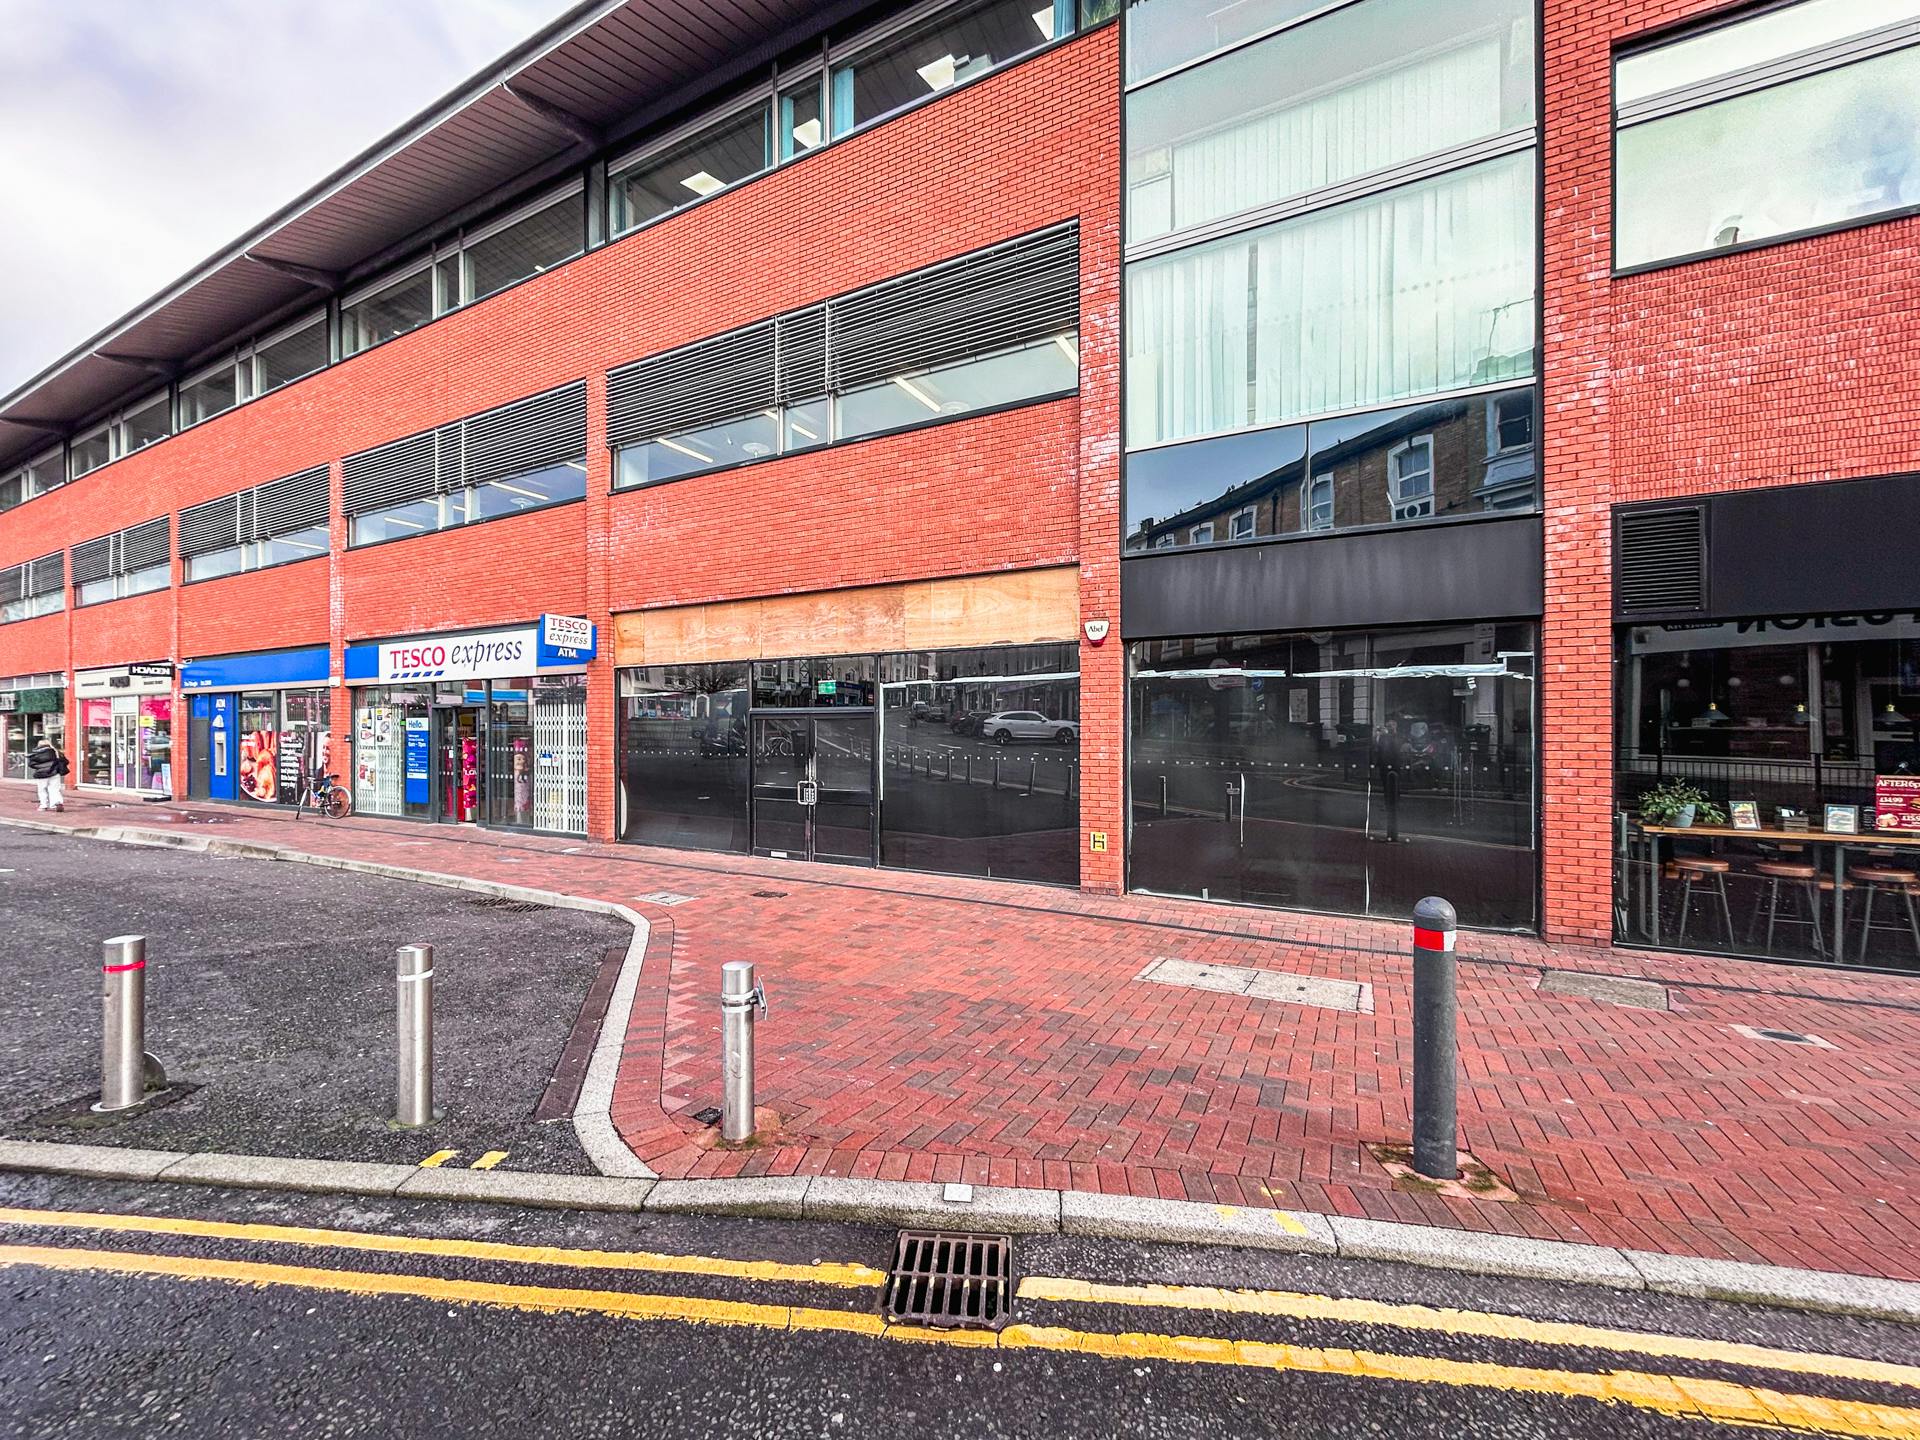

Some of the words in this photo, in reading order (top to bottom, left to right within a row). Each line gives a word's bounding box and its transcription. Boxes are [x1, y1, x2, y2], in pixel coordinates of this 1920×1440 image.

[549, 618, 588, 631] TESCO
[550, 633, 588, 645] express
[390, 646, 446, 669] TESCO
[451, 640, 522, 671] express
[558, 648, 577, 658] ATM
